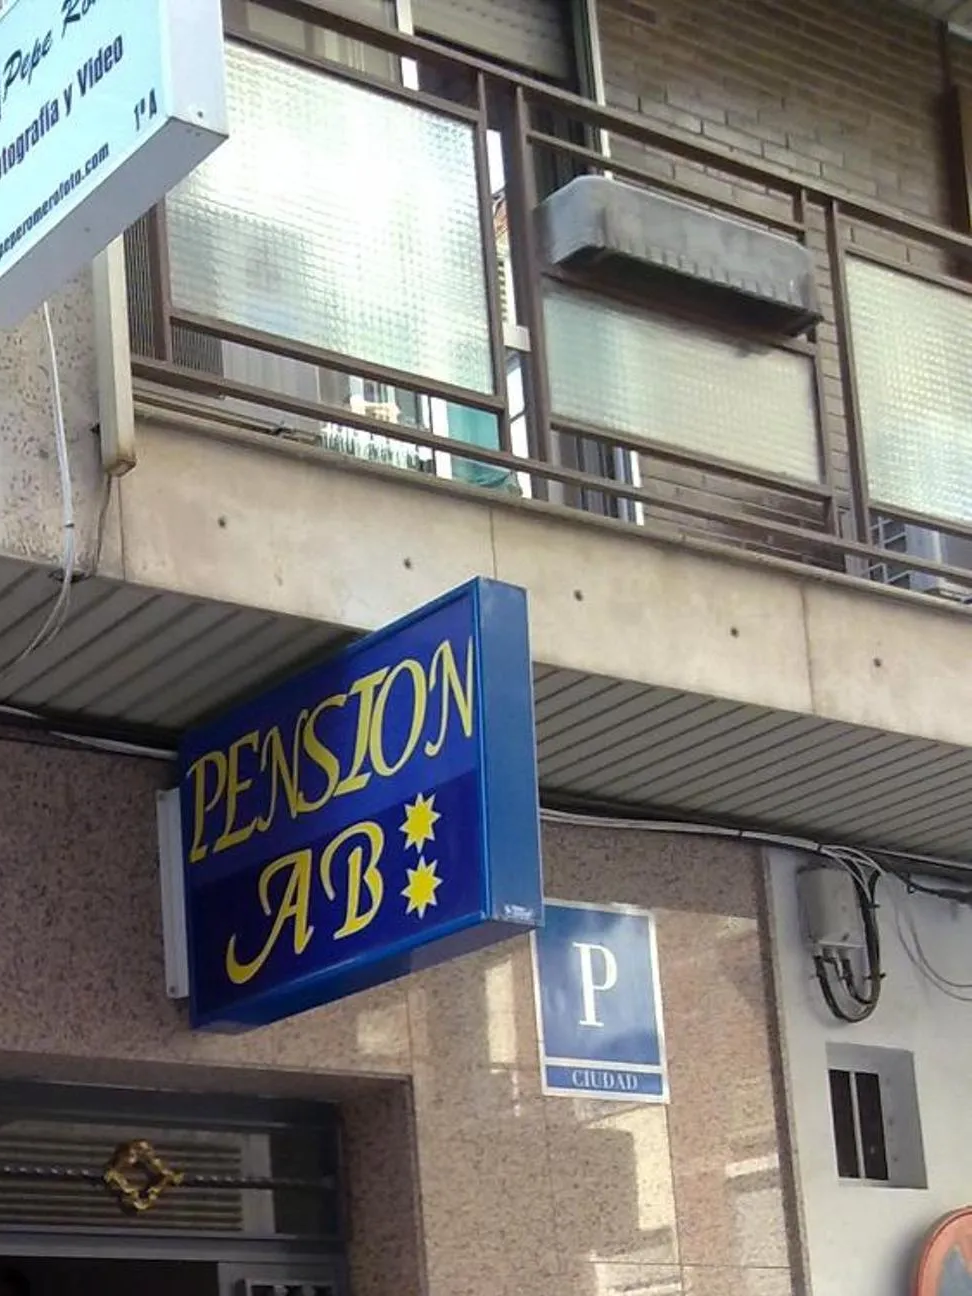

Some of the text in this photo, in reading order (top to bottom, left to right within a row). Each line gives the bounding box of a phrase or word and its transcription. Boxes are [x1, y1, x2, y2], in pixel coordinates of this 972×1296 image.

[63, 83, 73, 117] y
[187, 635, 474, 863] PENSION
[226, 820, 385, 984] AB
[572, 942, 618, 1028] P
[571, 1069, 638, 1090] CIUDAD
